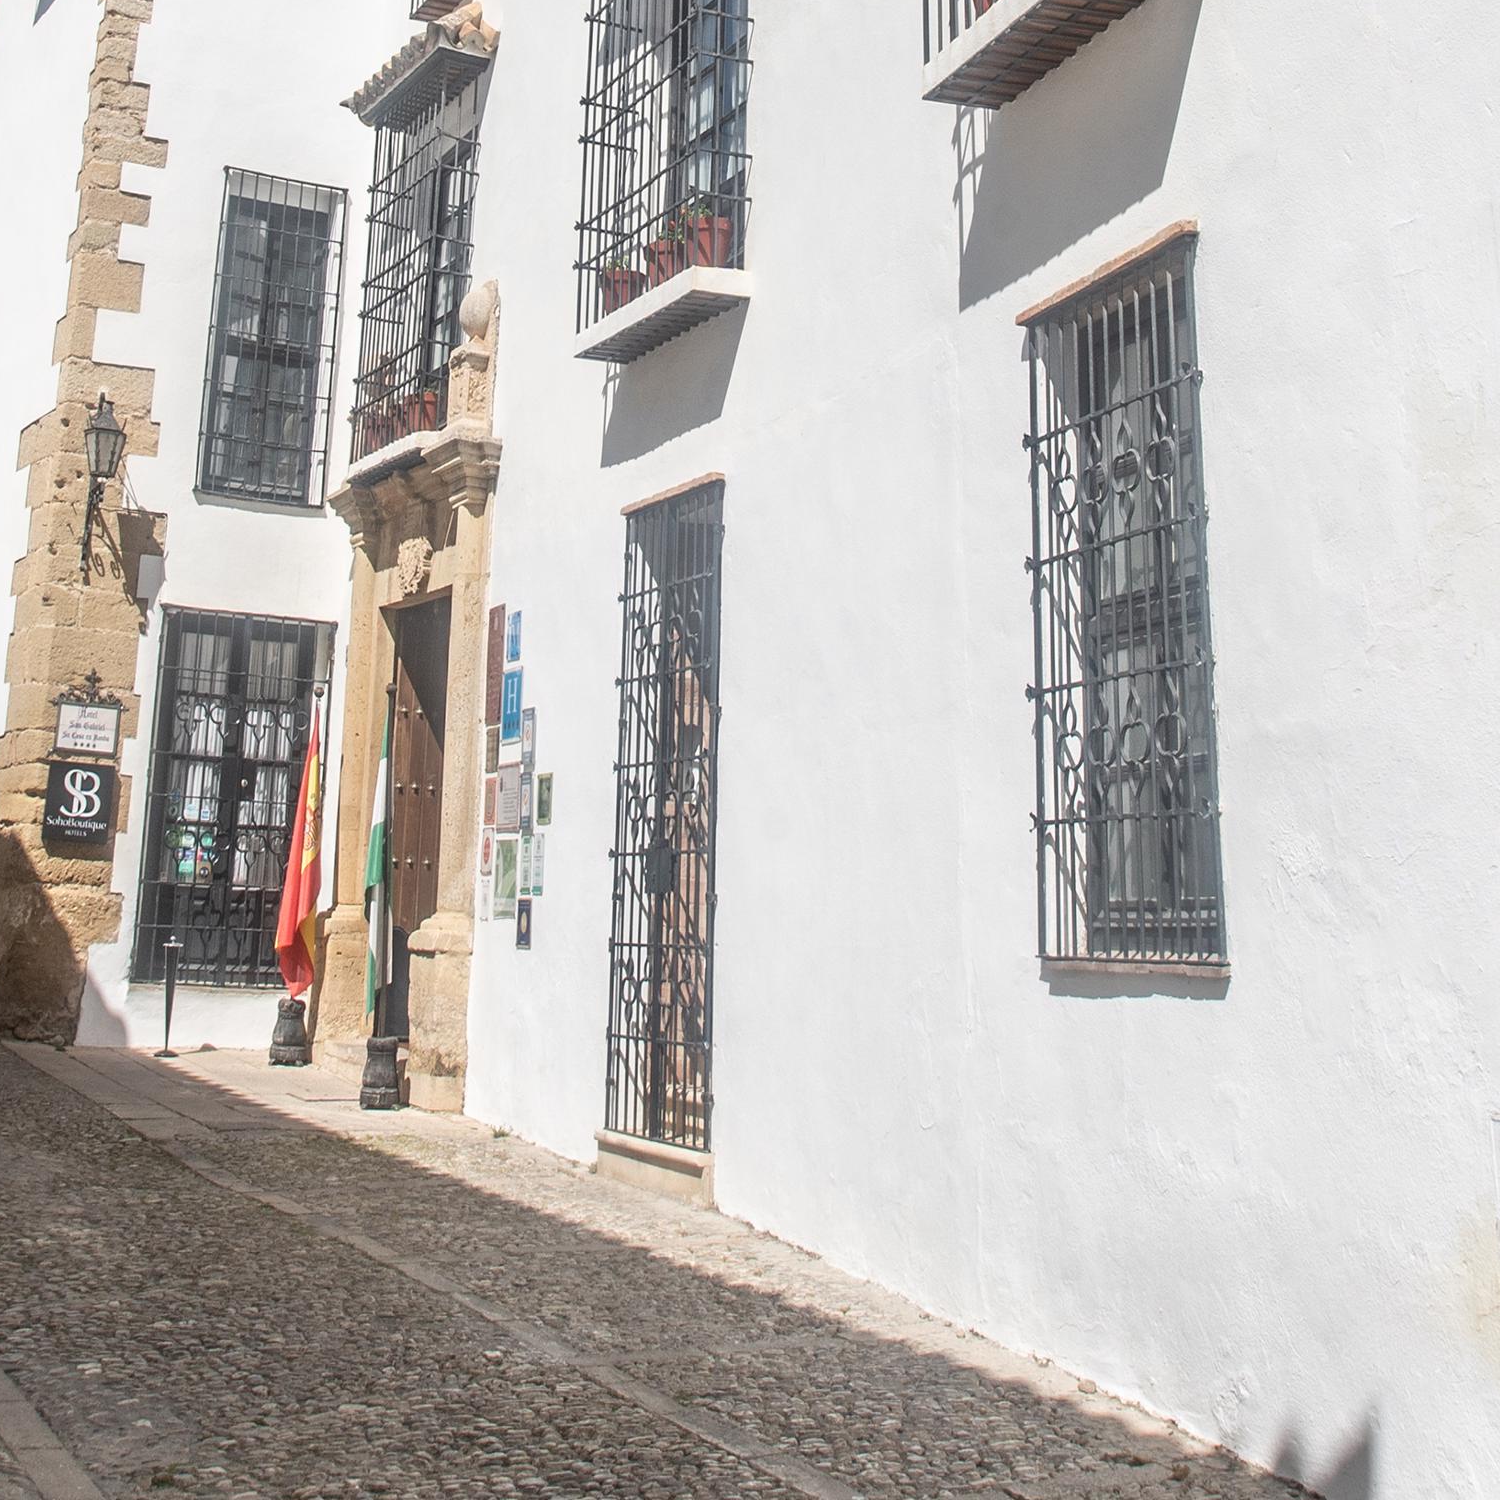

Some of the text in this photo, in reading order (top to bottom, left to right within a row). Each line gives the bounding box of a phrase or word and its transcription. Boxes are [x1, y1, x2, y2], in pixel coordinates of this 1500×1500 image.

[506, 678, 518, 714] H
[60, 768, 101, 818] SB
[46, 815, 107, 832] SohoBoutique
